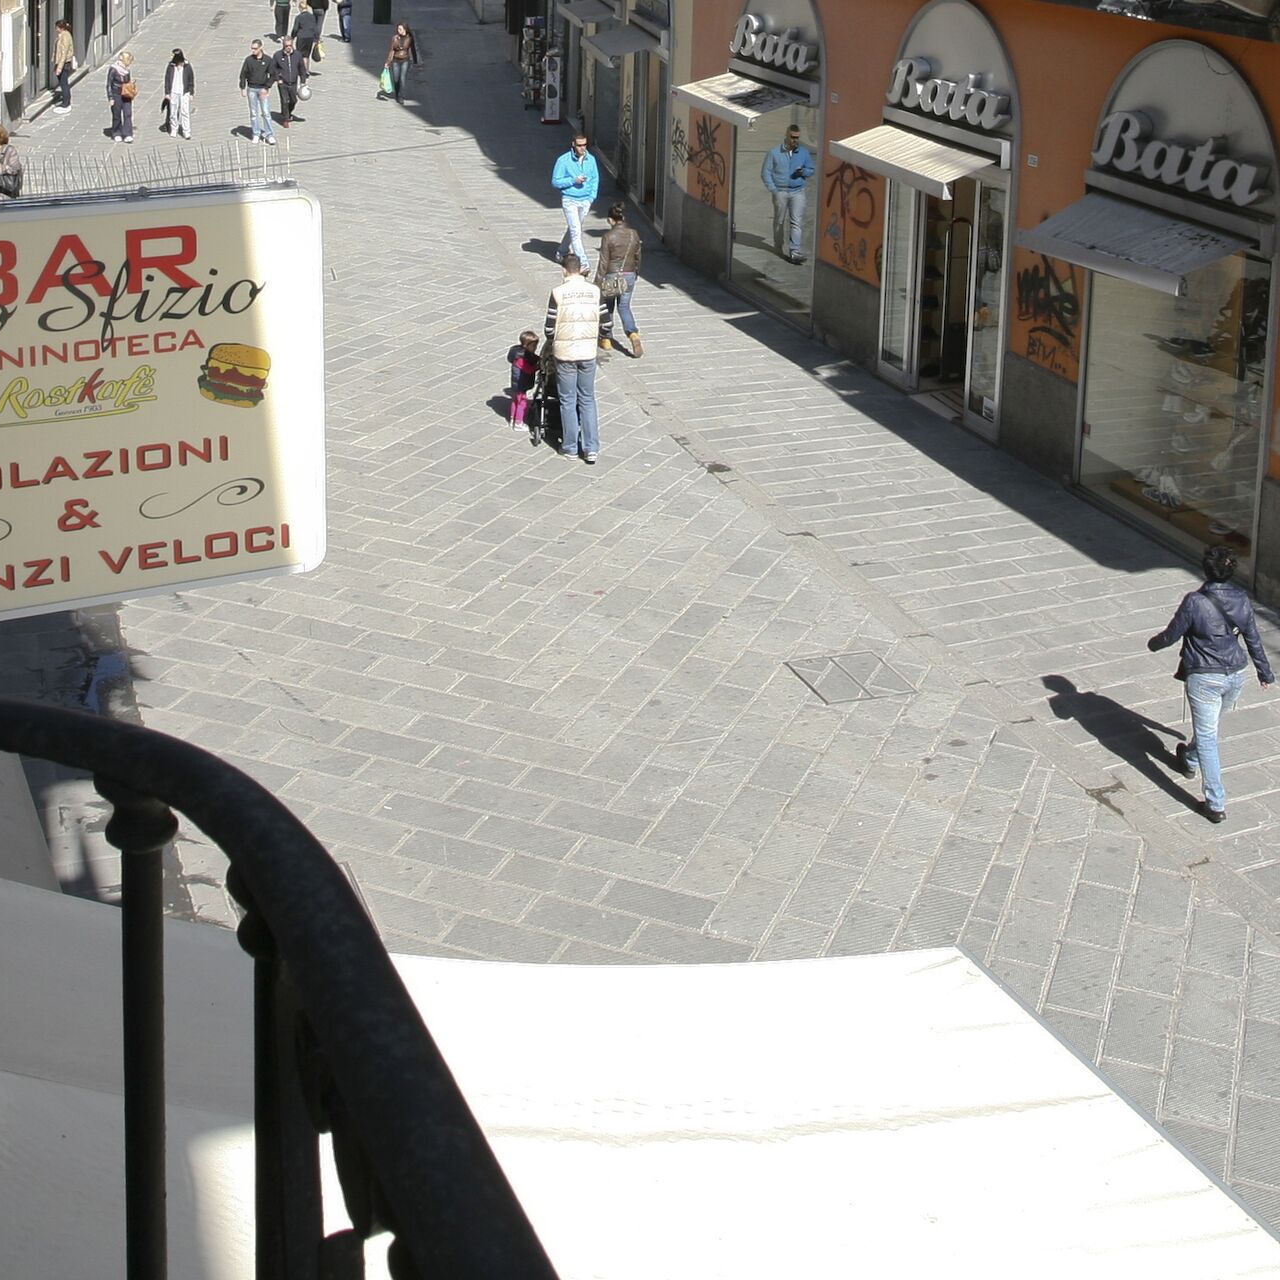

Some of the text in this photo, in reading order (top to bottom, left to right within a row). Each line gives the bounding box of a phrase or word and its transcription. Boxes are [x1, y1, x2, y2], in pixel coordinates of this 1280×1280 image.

[729, 13, 818, 73] Bata
[886, 57, 1012, 130] Bata
[1091, 111, 1263, 207] Bata
[37, 258, 266, 353] Sfizio
[57, 498, 102, 532] &
[98, 522, 291, 575] VELOCI
